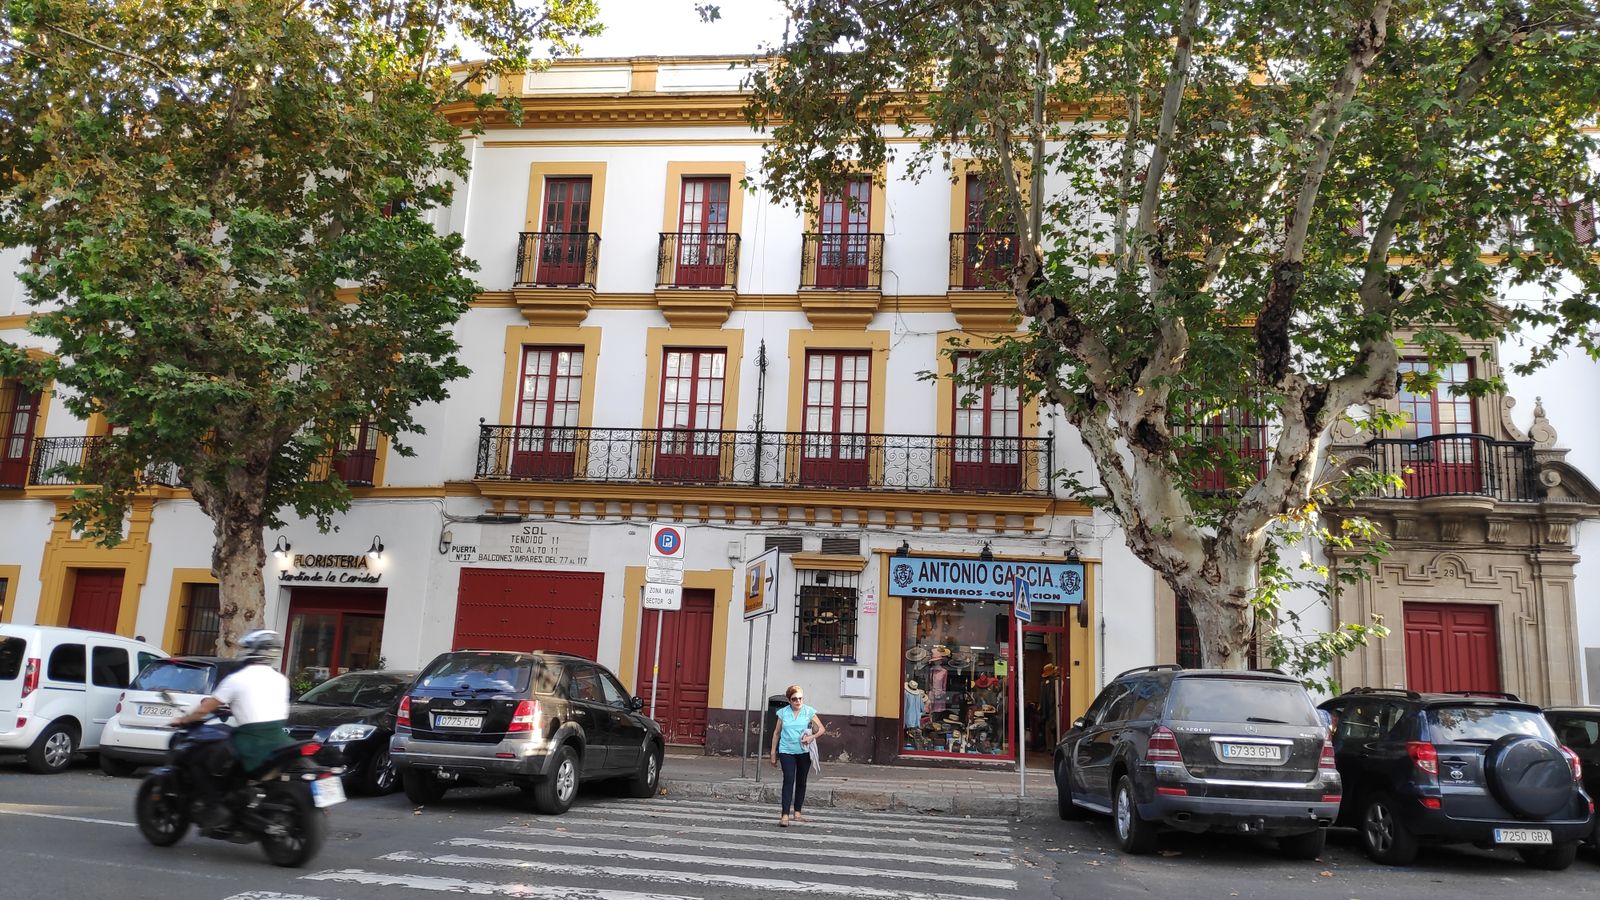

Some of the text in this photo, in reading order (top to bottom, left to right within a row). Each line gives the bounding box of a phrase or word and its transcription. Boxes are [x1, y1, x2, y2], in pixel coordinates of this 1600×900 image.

[523, 526, 548, 535] SOL
[511, 535, 543, 544] TENDIDO
[451, 545, 477, 554] PUERTA
[509, 546, 523, 554] SOL
[526, 546, 547, 554] ALTO
[293, 554, 369, 570] FLORISTERIA
[478, 553, 513, 562] BALCONES
[514, 554, 543, 564] IMPARES
[545, 555, 558, 564] DEL
[559, 556, 569, 565] 77
[577, 557, 588, 565] 117
[325, 571, 337, 582] la
[339, 572, 382, 584] Caridad
[918, 561, 1054, 587] ANTONIO GARCIA
[1443, 568, 1455, 577] 29
[645, 597, 664, 605] SECTOR
[442, 716, 480, 727] 0775 FCJ
[1230, 746, 1278, 758] 6733 GPV
[1502, 830, 1549, 842] 7250 GBX
